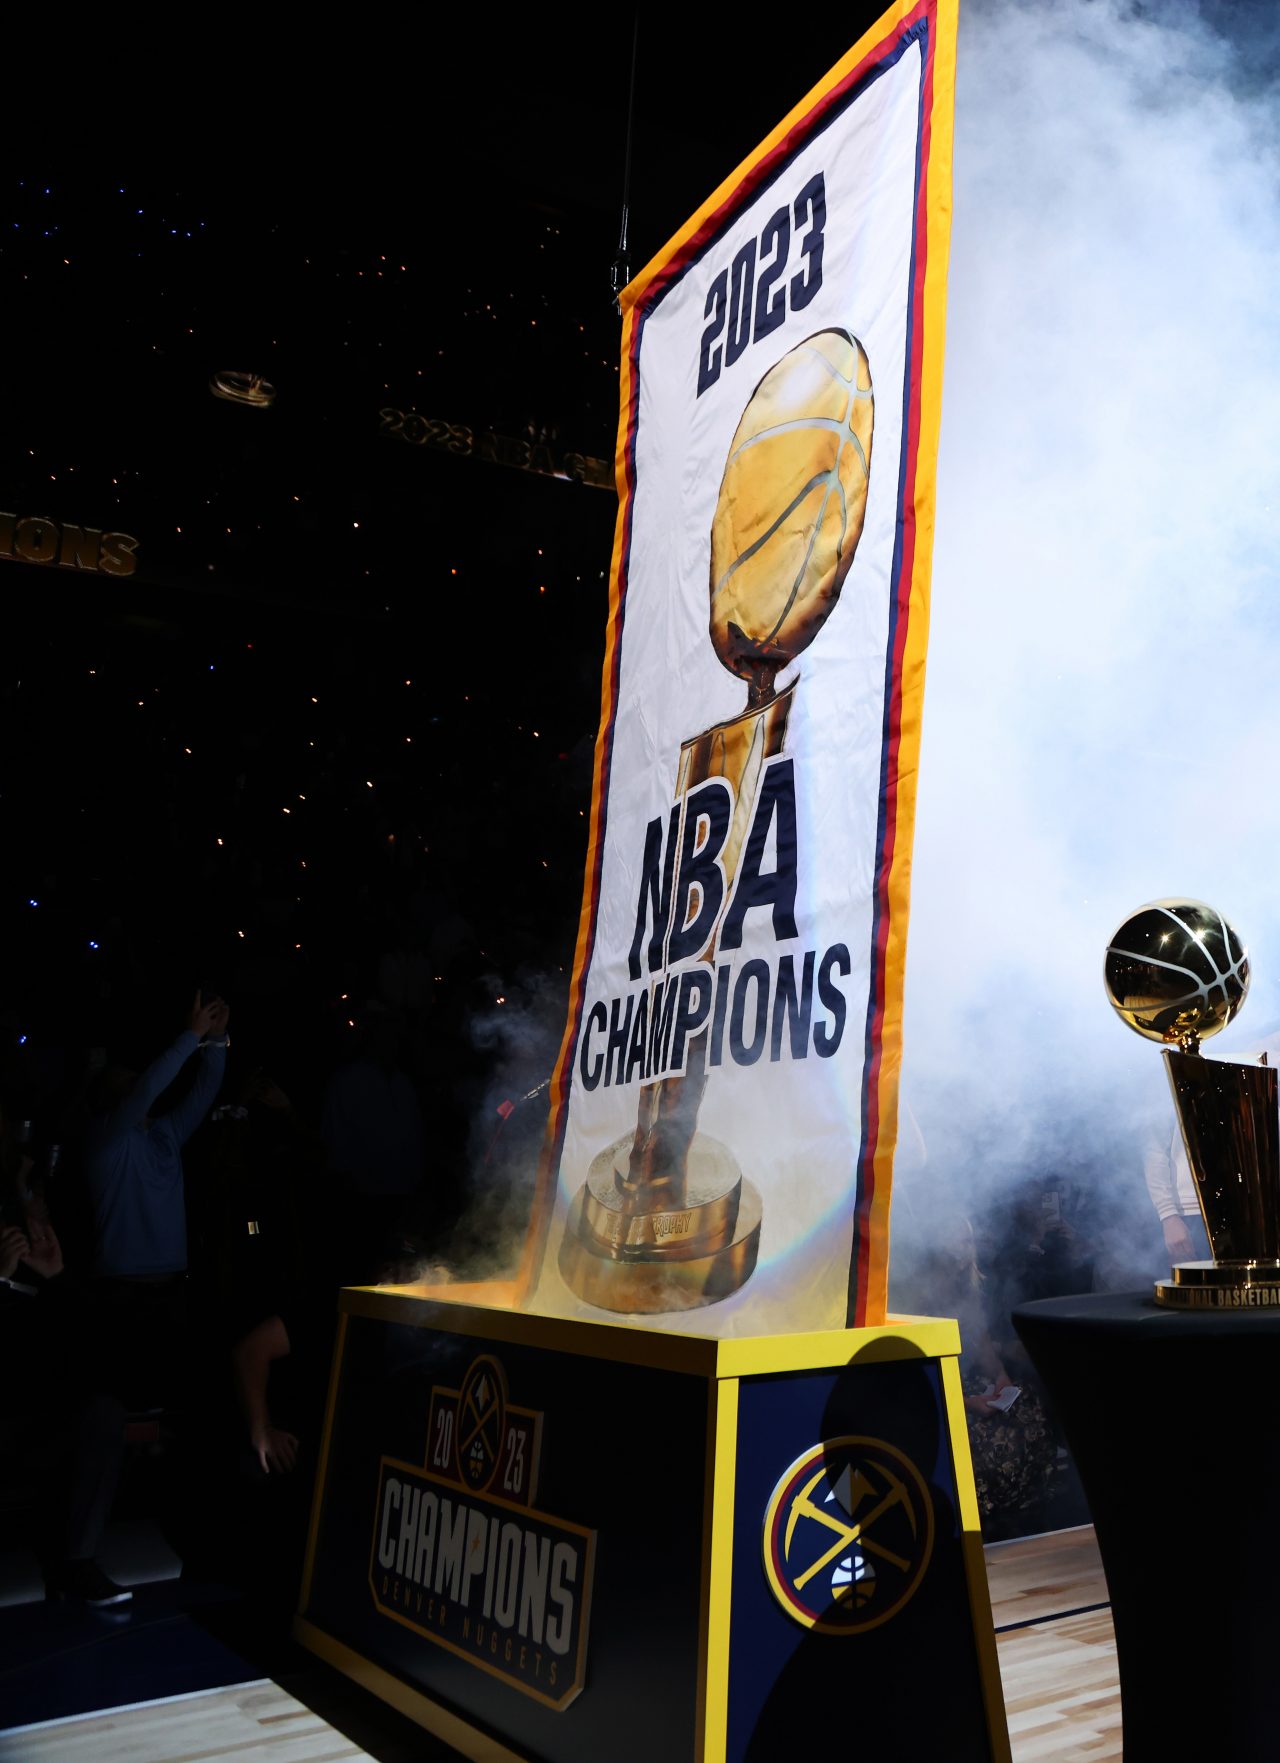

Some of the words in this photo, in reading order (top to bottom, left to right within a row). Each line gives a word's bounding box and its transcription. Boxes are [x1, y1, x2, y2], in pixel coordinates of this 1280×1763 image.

[697, 171, 827, 399] 2023
[378, 408, 473, 455] 2023
[628, 758, 798, 981] NBA
[580, 942, 852, 1093] CHAMPIONS
[432, 1408, 454, 1470] 20
[503, 1427, 527, 1495] 23
[377, 1477, 578, 1656] CHAMPIONS
[381, 1574, 446, 1627] DENVER
[462, 1616, 558, 1687] NUGGETS
